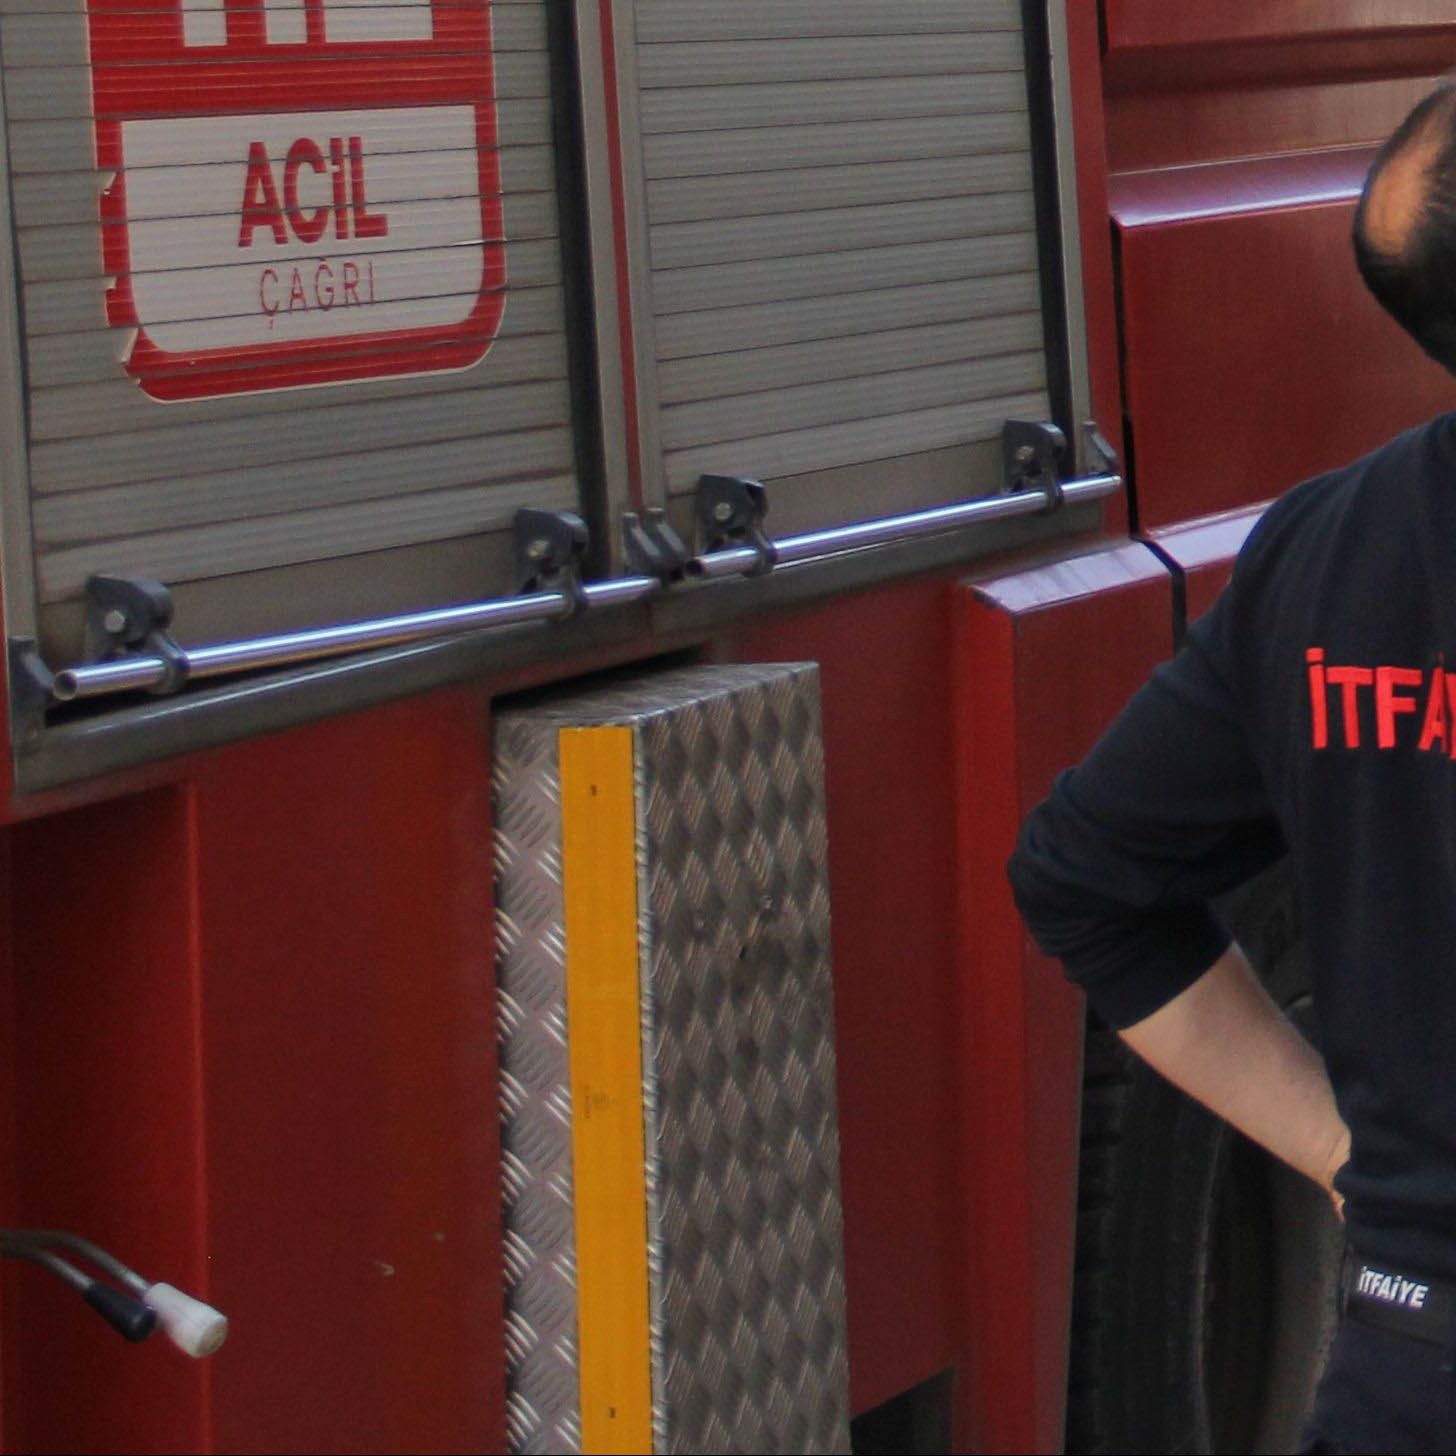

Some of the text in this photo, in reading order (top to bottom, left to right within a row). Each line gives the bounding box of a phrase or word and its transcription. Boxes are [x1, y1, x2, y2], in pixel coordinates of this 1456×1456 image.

[238, 136, 389, 249] ACİL
[259, 259, 375, 329] ÇAĞRI
[1358, 1266, 1429, 1309] İTFAİYE
